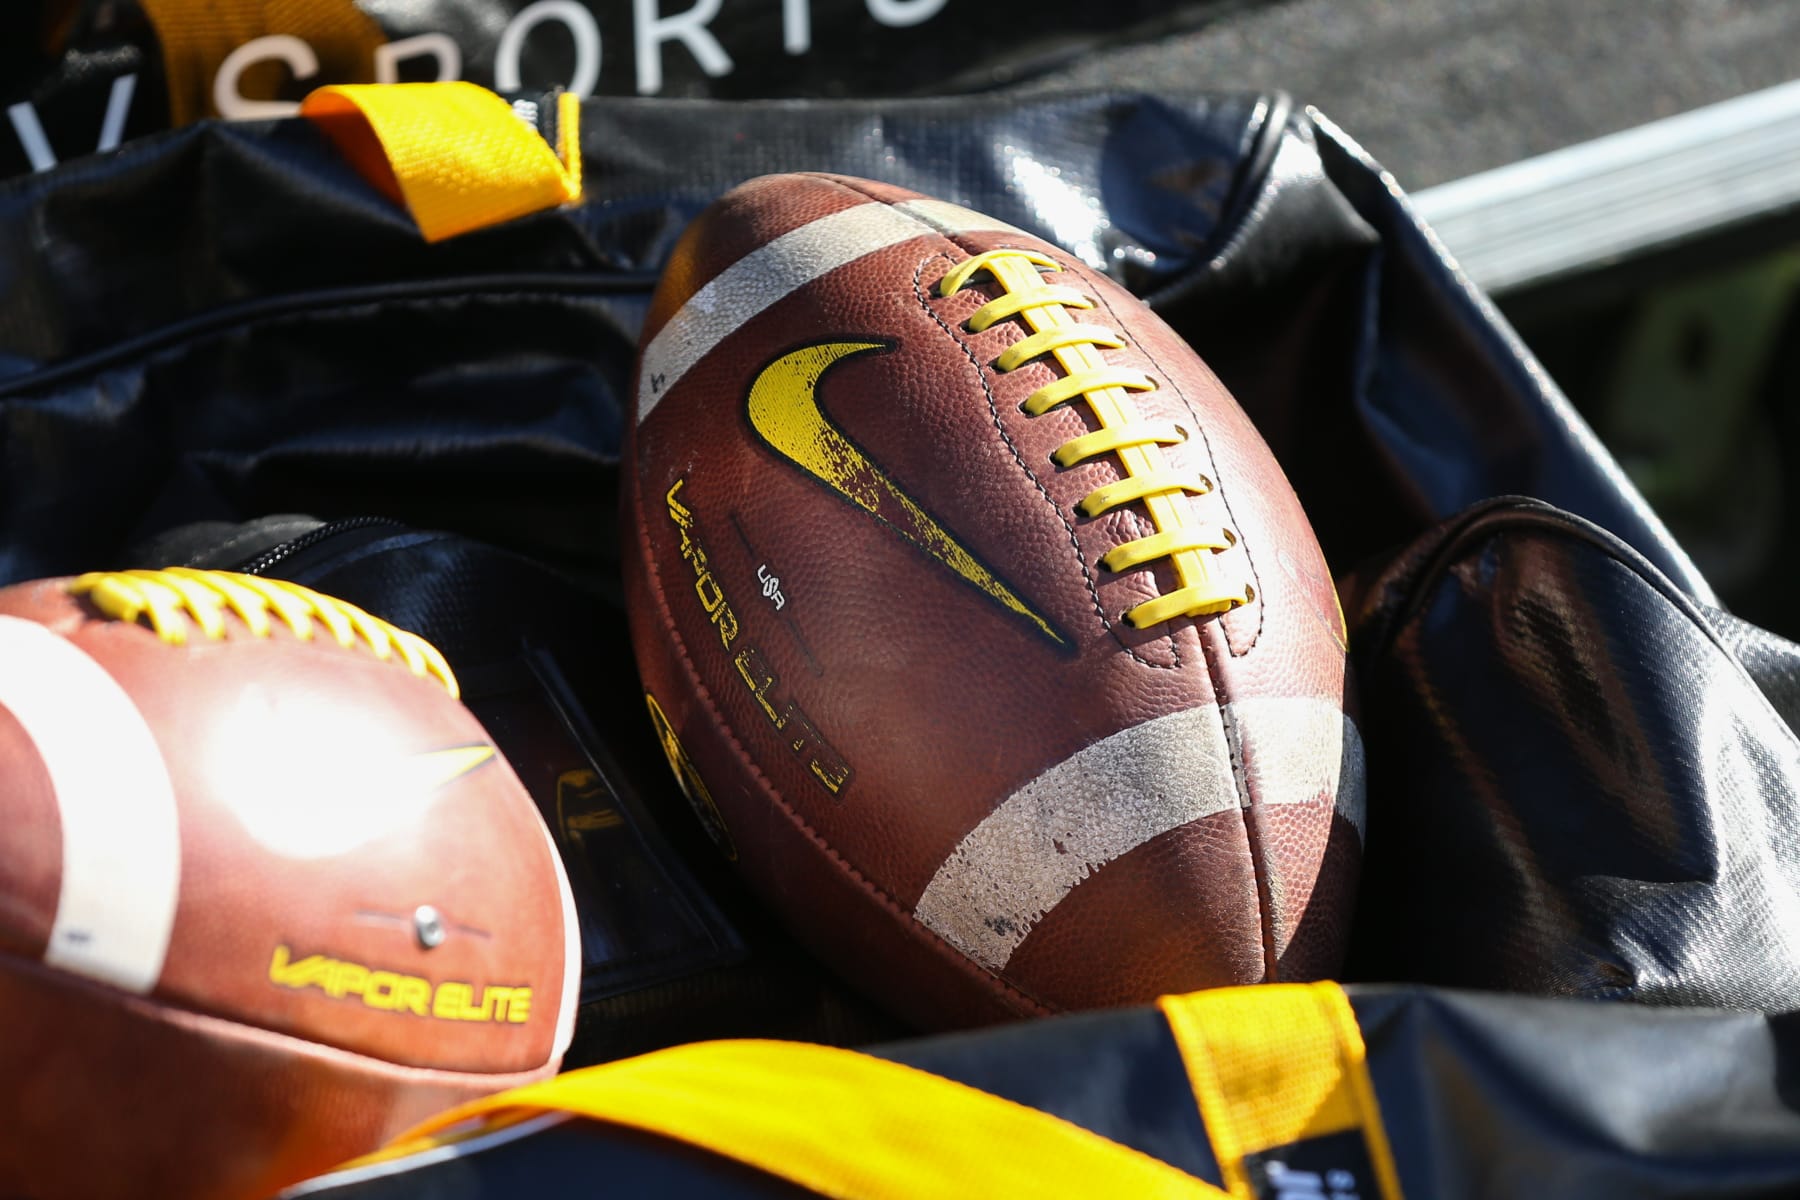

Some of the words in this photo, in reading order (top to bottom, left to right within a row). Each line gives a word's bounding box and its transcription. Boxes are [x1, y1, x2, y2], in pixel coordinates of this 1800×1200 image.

[757, 564, 785, 611] USA
[269, 944, 432, 1019] VAPOR
[432, 981, 533, 1024] ELITE
